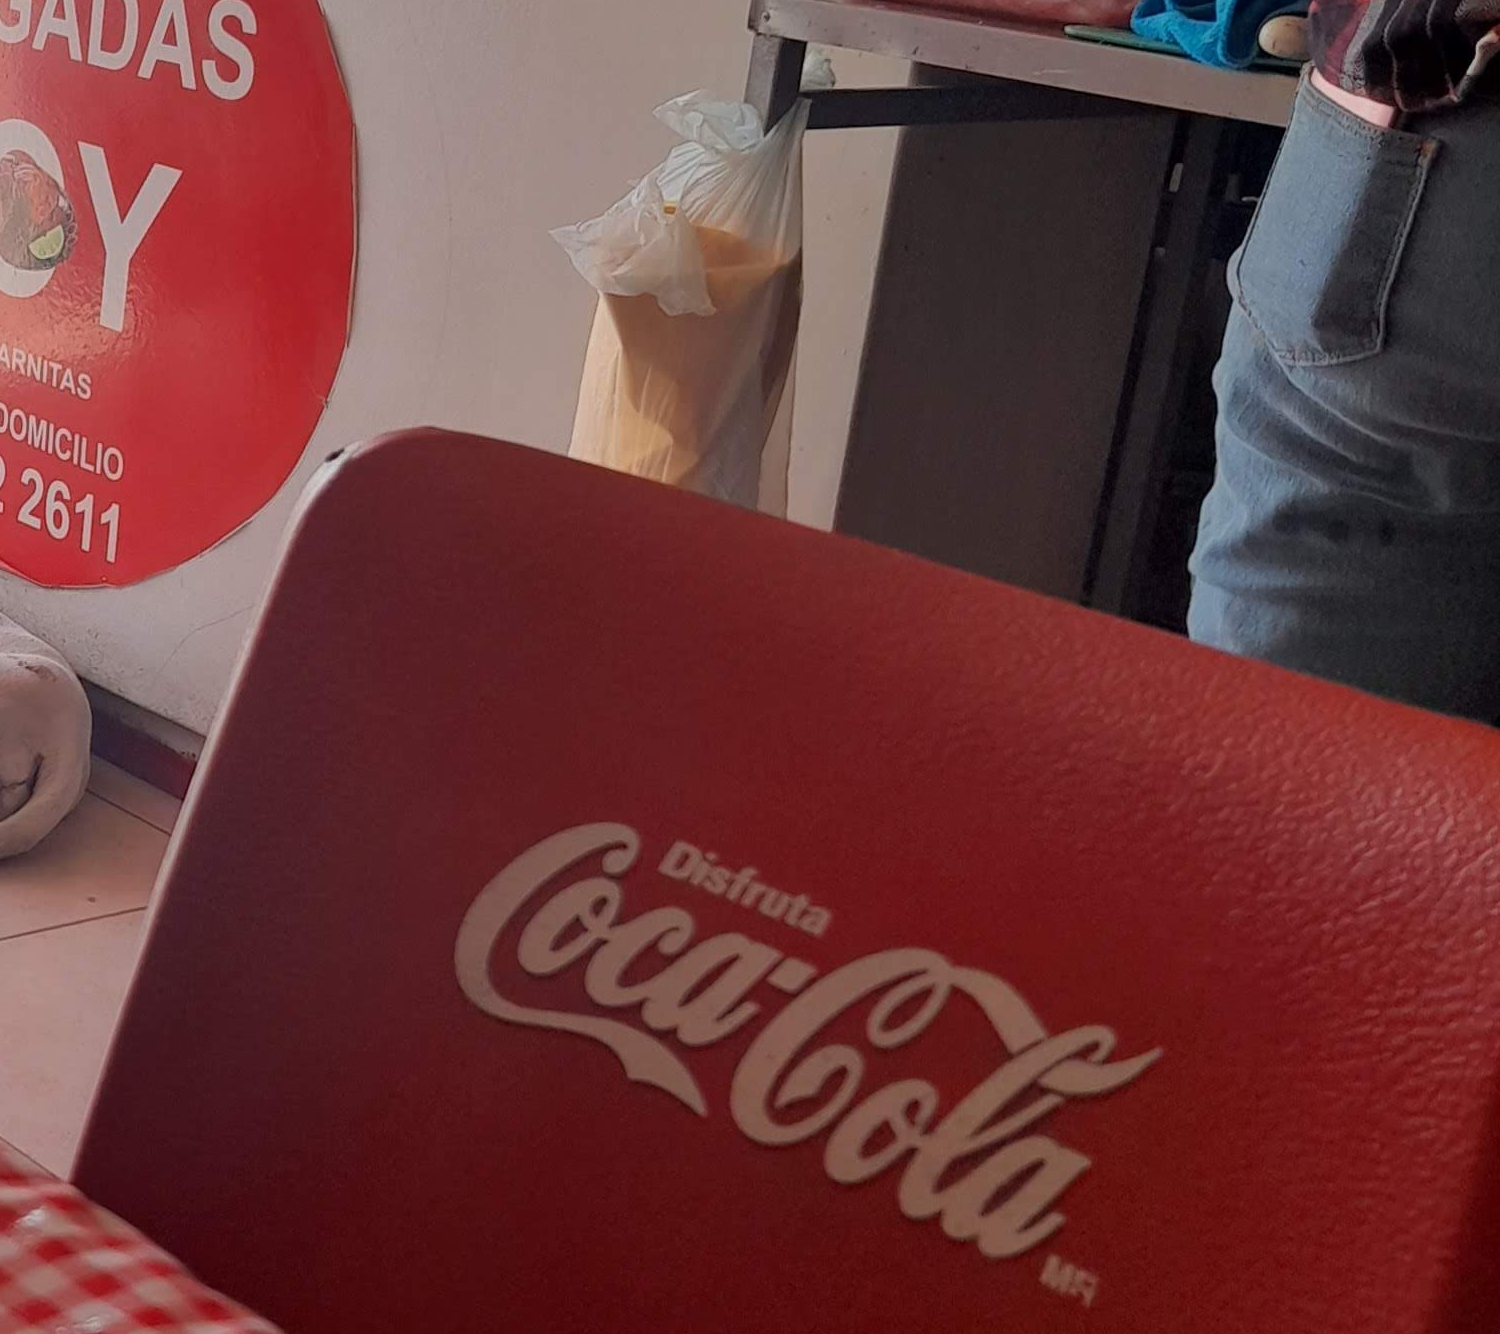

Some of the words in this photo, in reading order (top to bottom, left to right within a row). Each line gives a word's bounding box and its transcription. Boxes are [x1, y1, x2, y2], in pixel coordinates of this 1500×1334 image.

[17, 467, 120, 564] 2611
[657, 840, 834, 939] Disfruta
[453, 821, 1165, 1261] Coca-Cola
